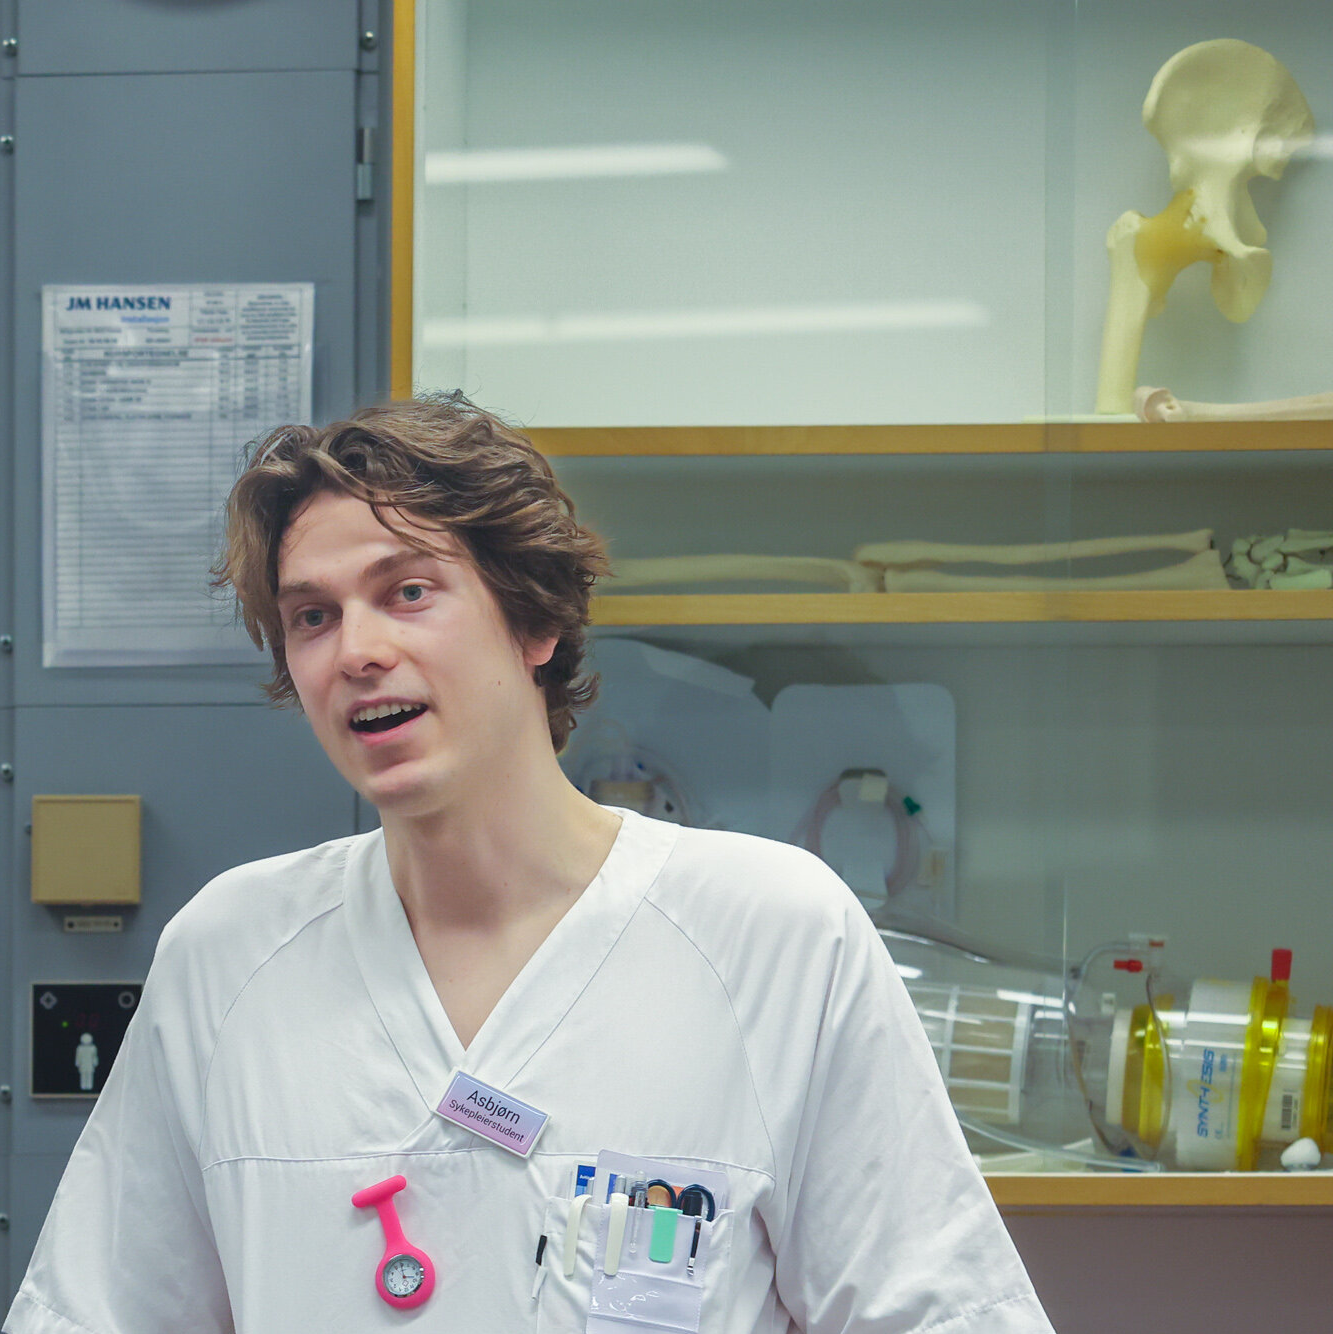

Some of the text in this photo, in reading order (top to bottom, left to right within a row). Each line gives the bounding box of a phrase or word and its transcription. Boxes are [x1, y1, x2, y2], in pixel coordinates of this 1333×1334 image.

[66, 296, 171, 311] JM HANSEN
[449, 1099, 525, 1143] Sykepleierstudent
[466, 1090, 521, 1125] Asbjørn
